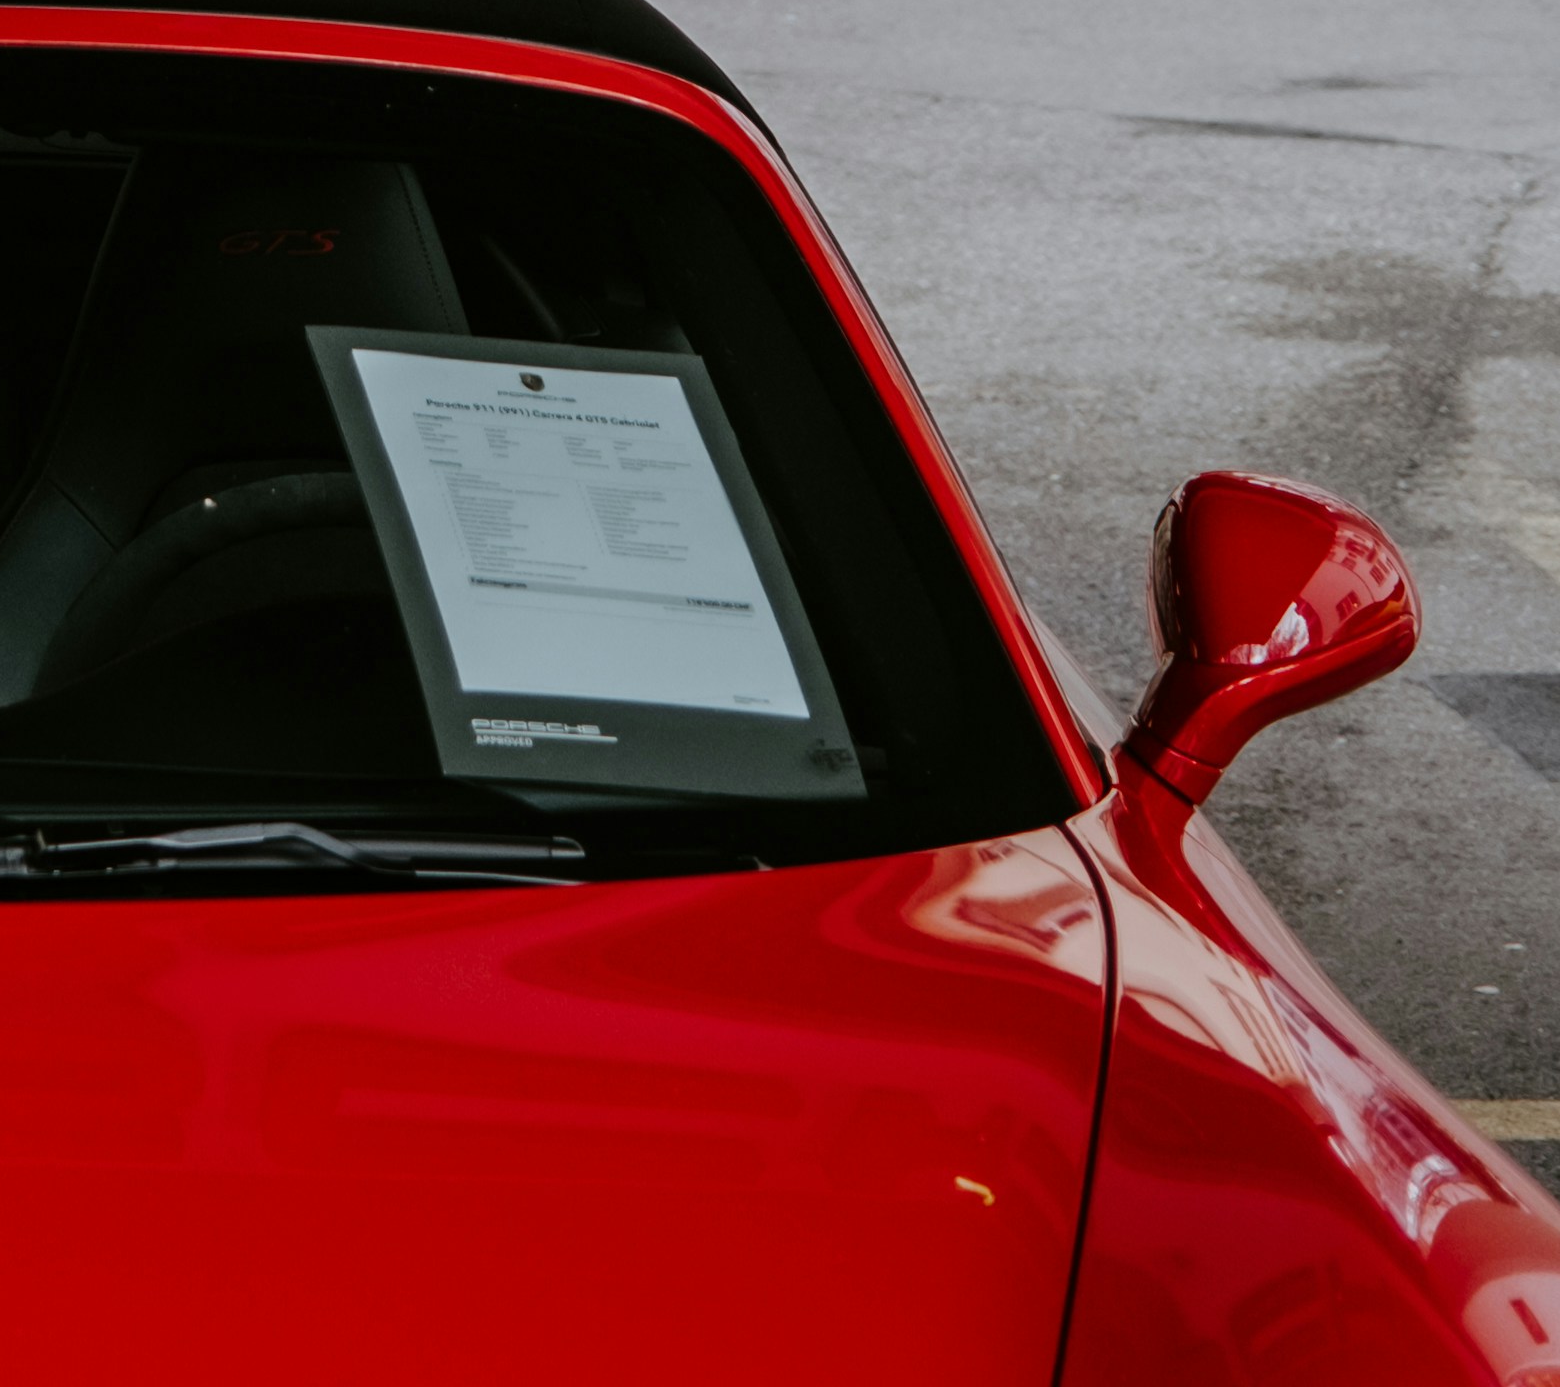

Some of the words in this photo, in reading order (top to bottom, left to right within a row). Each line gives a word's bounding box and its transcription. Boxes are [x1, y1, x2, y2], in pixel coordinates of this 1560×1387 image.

[218, 229, 342, 258] GTS
[425, 397, 471, 411] Porsche
[473, 402, 496, 415] 911
[532, 409, 574, 423] Carrera
[585, 414, 609, 425] GTS
[610, 416, 661, 430] Cabriolet
[470, 717, 602, 736] PORSCHE
[475, 734, 534, 749] APPROVED
